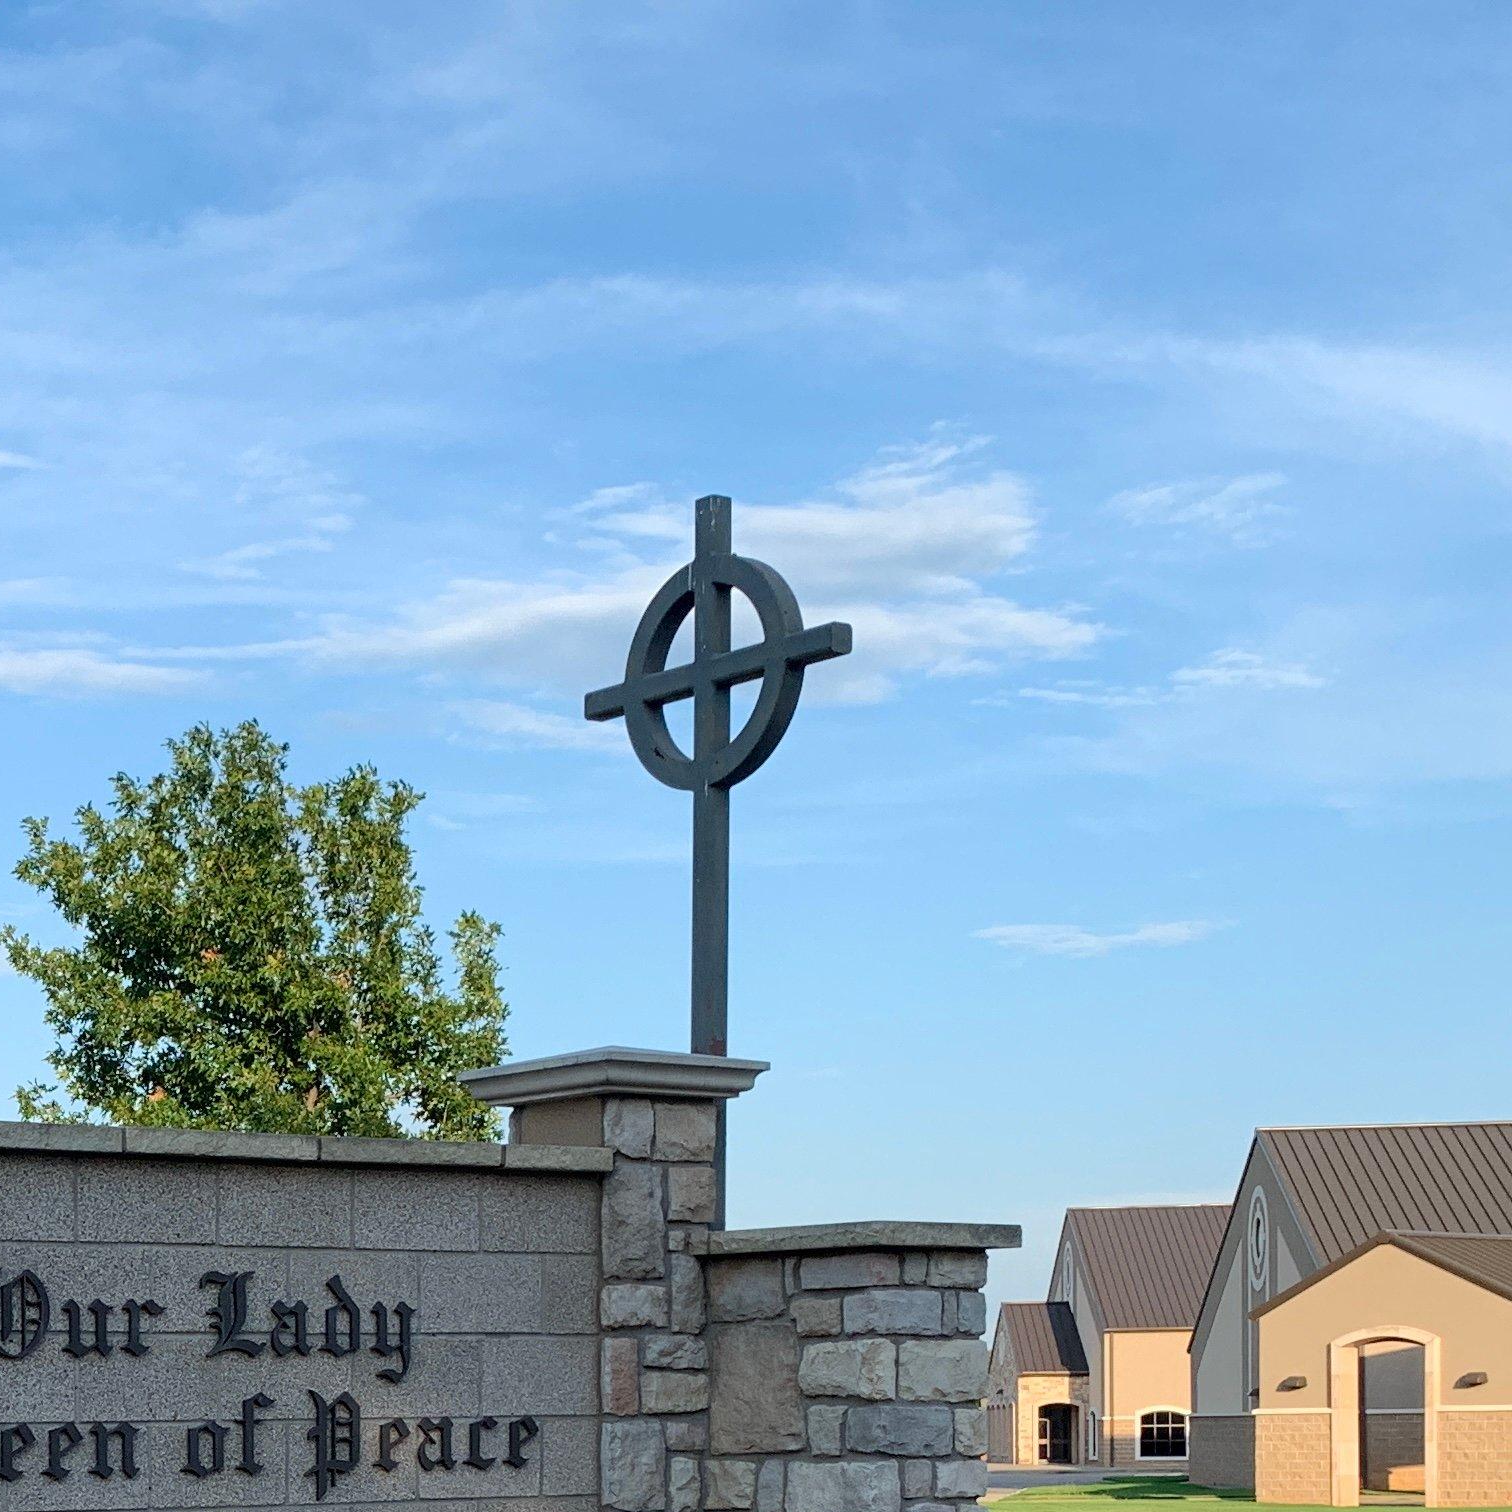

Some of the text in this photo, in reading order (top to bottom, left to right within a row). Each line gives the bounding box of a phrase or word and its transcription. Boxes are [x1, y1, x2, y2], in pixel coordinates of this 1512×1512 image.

[200, 1270, 416, 1384] Lady
[180, 1390, 275, 1478] of
[306, 1388, 540, 1500] Peace
